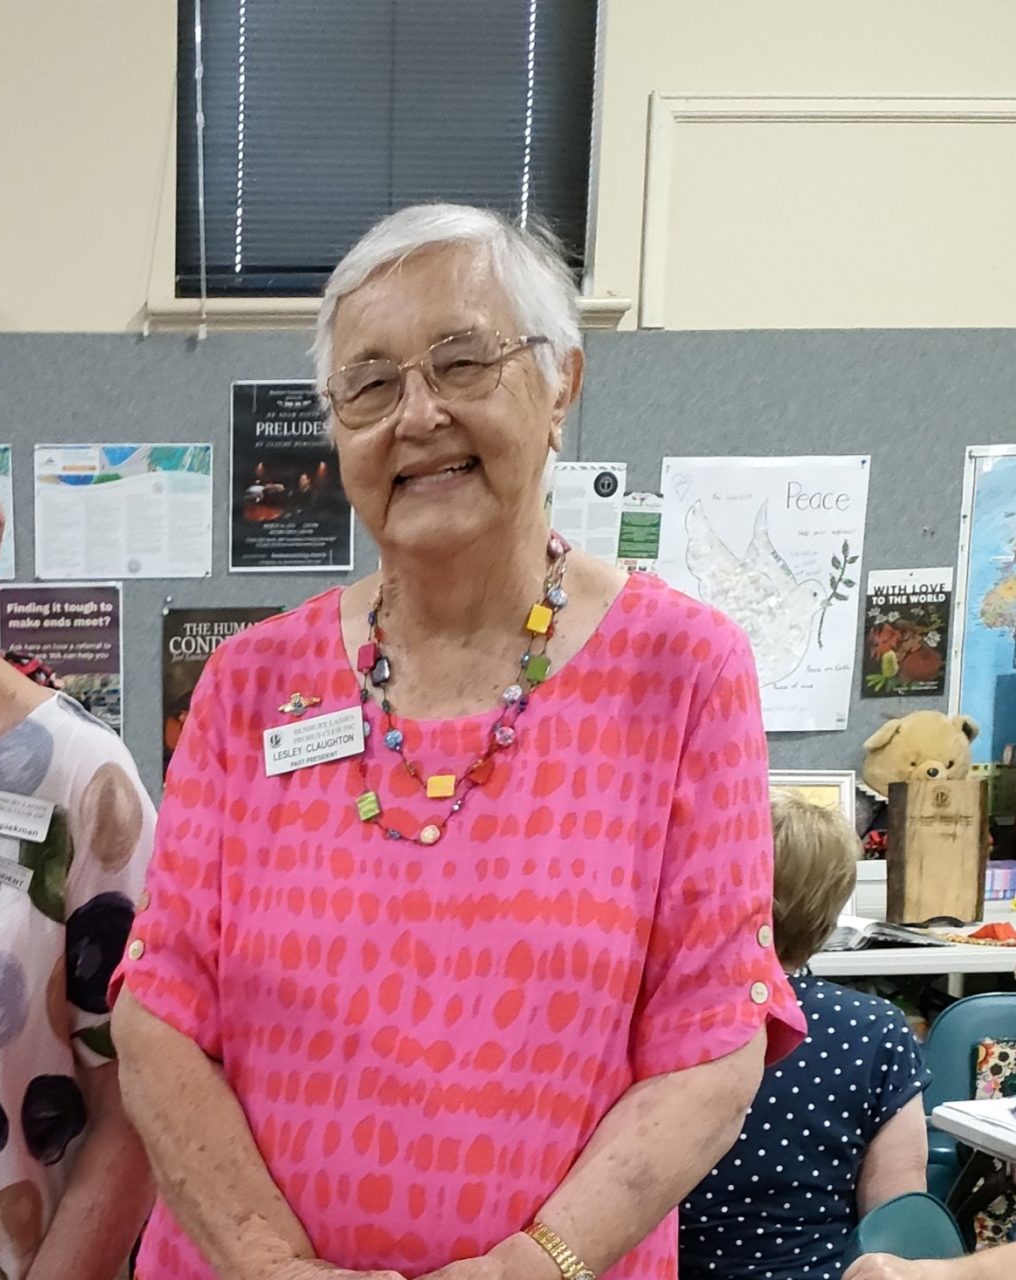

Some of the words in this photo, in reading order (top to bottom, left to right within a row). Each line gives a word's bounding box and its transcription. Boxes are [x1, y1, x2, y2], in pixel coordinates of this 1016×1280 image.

[256, 421, 329, 436] PRELUDES
[786, 481, 850, 511] Peace
[873, 585, 907, 596] WITH
[912, 583, 946, 593] LOVE
[872, 596, 886, 605] TO
[888, 595, 907, 604] THE
[909, 593, 946, 603] WORLD
[6, 602, 50, 616] Finding
[52, 602, 62, 613] it
[64, 601, 98, 615] tough
[99, 602, 113, 612] to
[8, 617, 41, 629] make
[43, 617, 72, 628] ends
[73, 616, 111, 628] meet?
[183, 622, 212, 635] THE
[273, 747, 302, 761] LESLEY
[305, 734, 355, 753] CLAUGHTON
